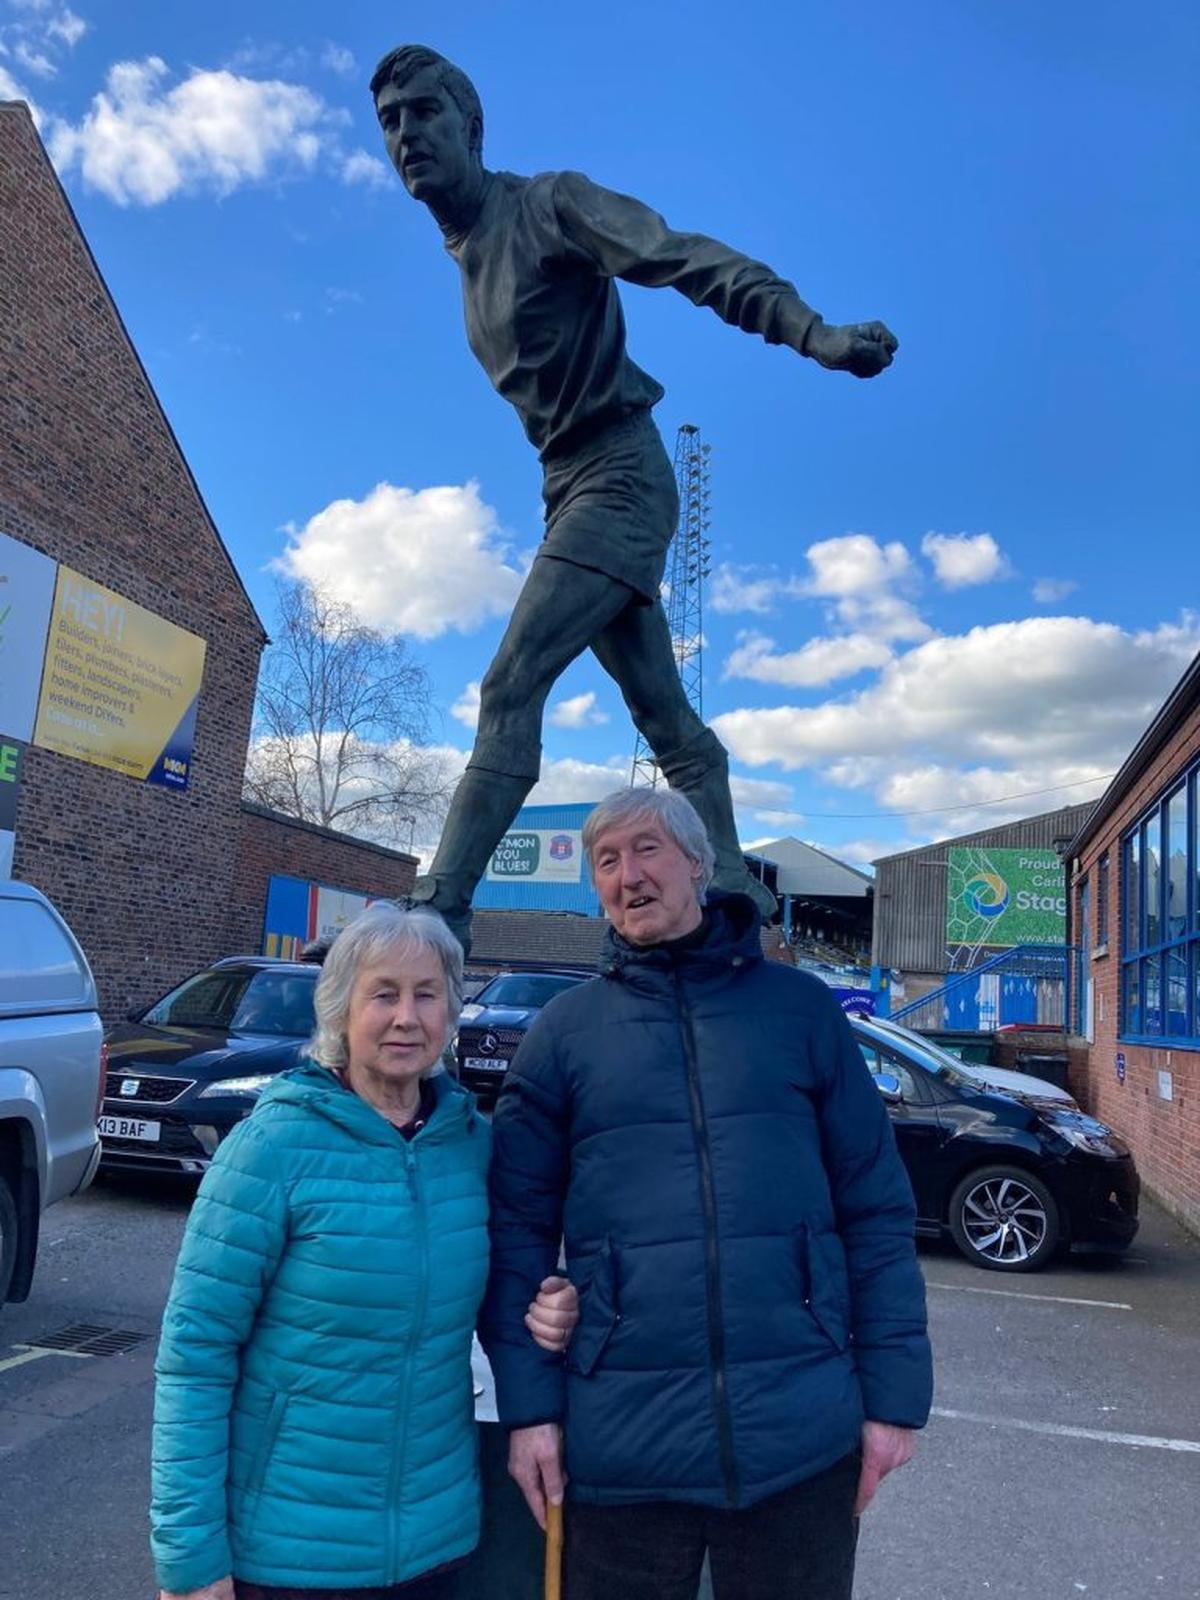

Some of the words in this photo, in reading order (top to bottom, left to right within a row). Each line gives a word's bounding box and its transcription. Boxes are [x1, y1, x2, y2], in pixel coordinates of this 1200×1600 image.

[495, 849, 520, 860] YOU
[494, 860, 530, 872] BLUES!
[1019, 857, 1061, 870] Proud
[119, 1121, 147, 1137] BAF
